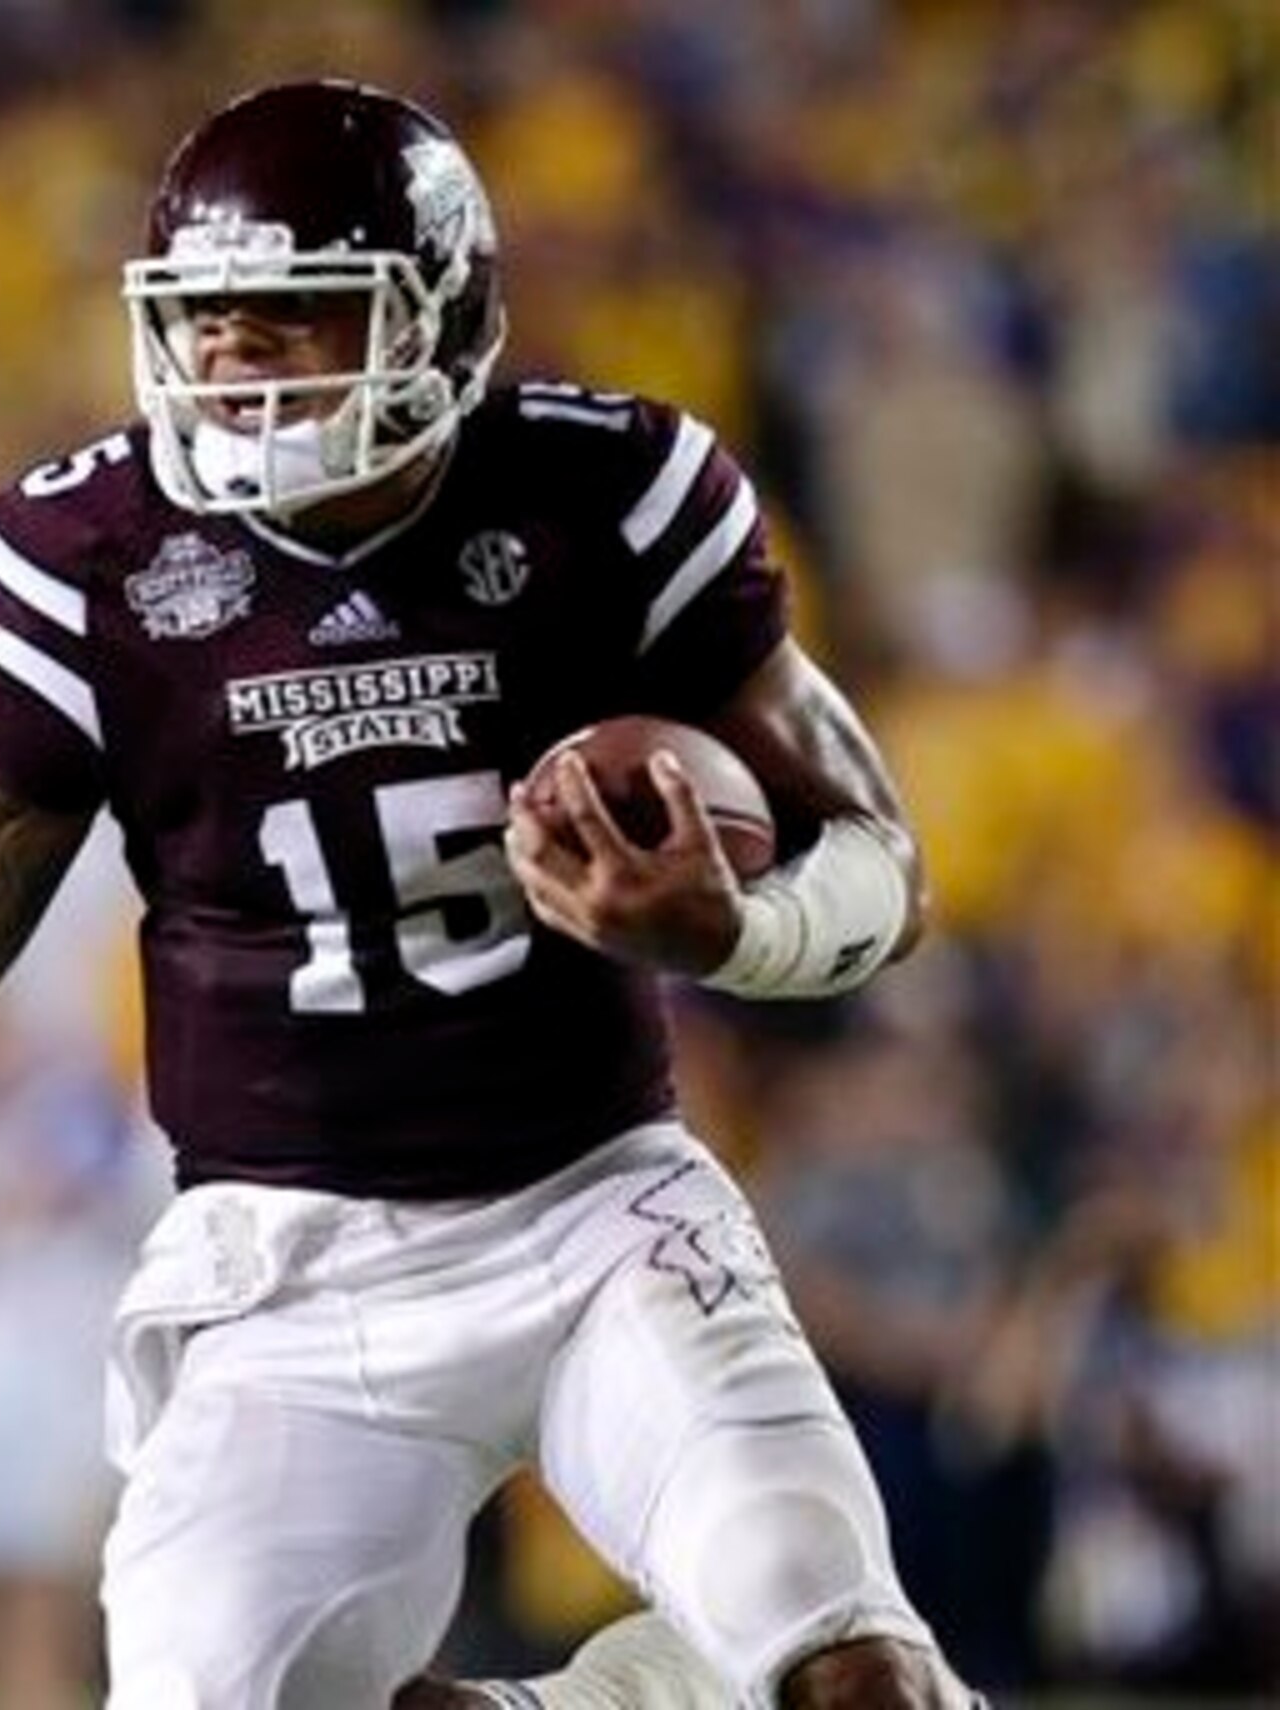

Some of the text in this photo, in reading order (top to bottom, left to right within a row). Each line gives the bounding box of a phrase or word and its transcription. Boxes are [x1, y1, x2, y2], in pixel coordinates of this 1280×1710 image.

[459, 530, 530, 606] SEC
[227, 661, 500, 724] MISSISSIPPI
[309, 709, 440, 757] STATE
[258, 768, 532, 1014] 15
